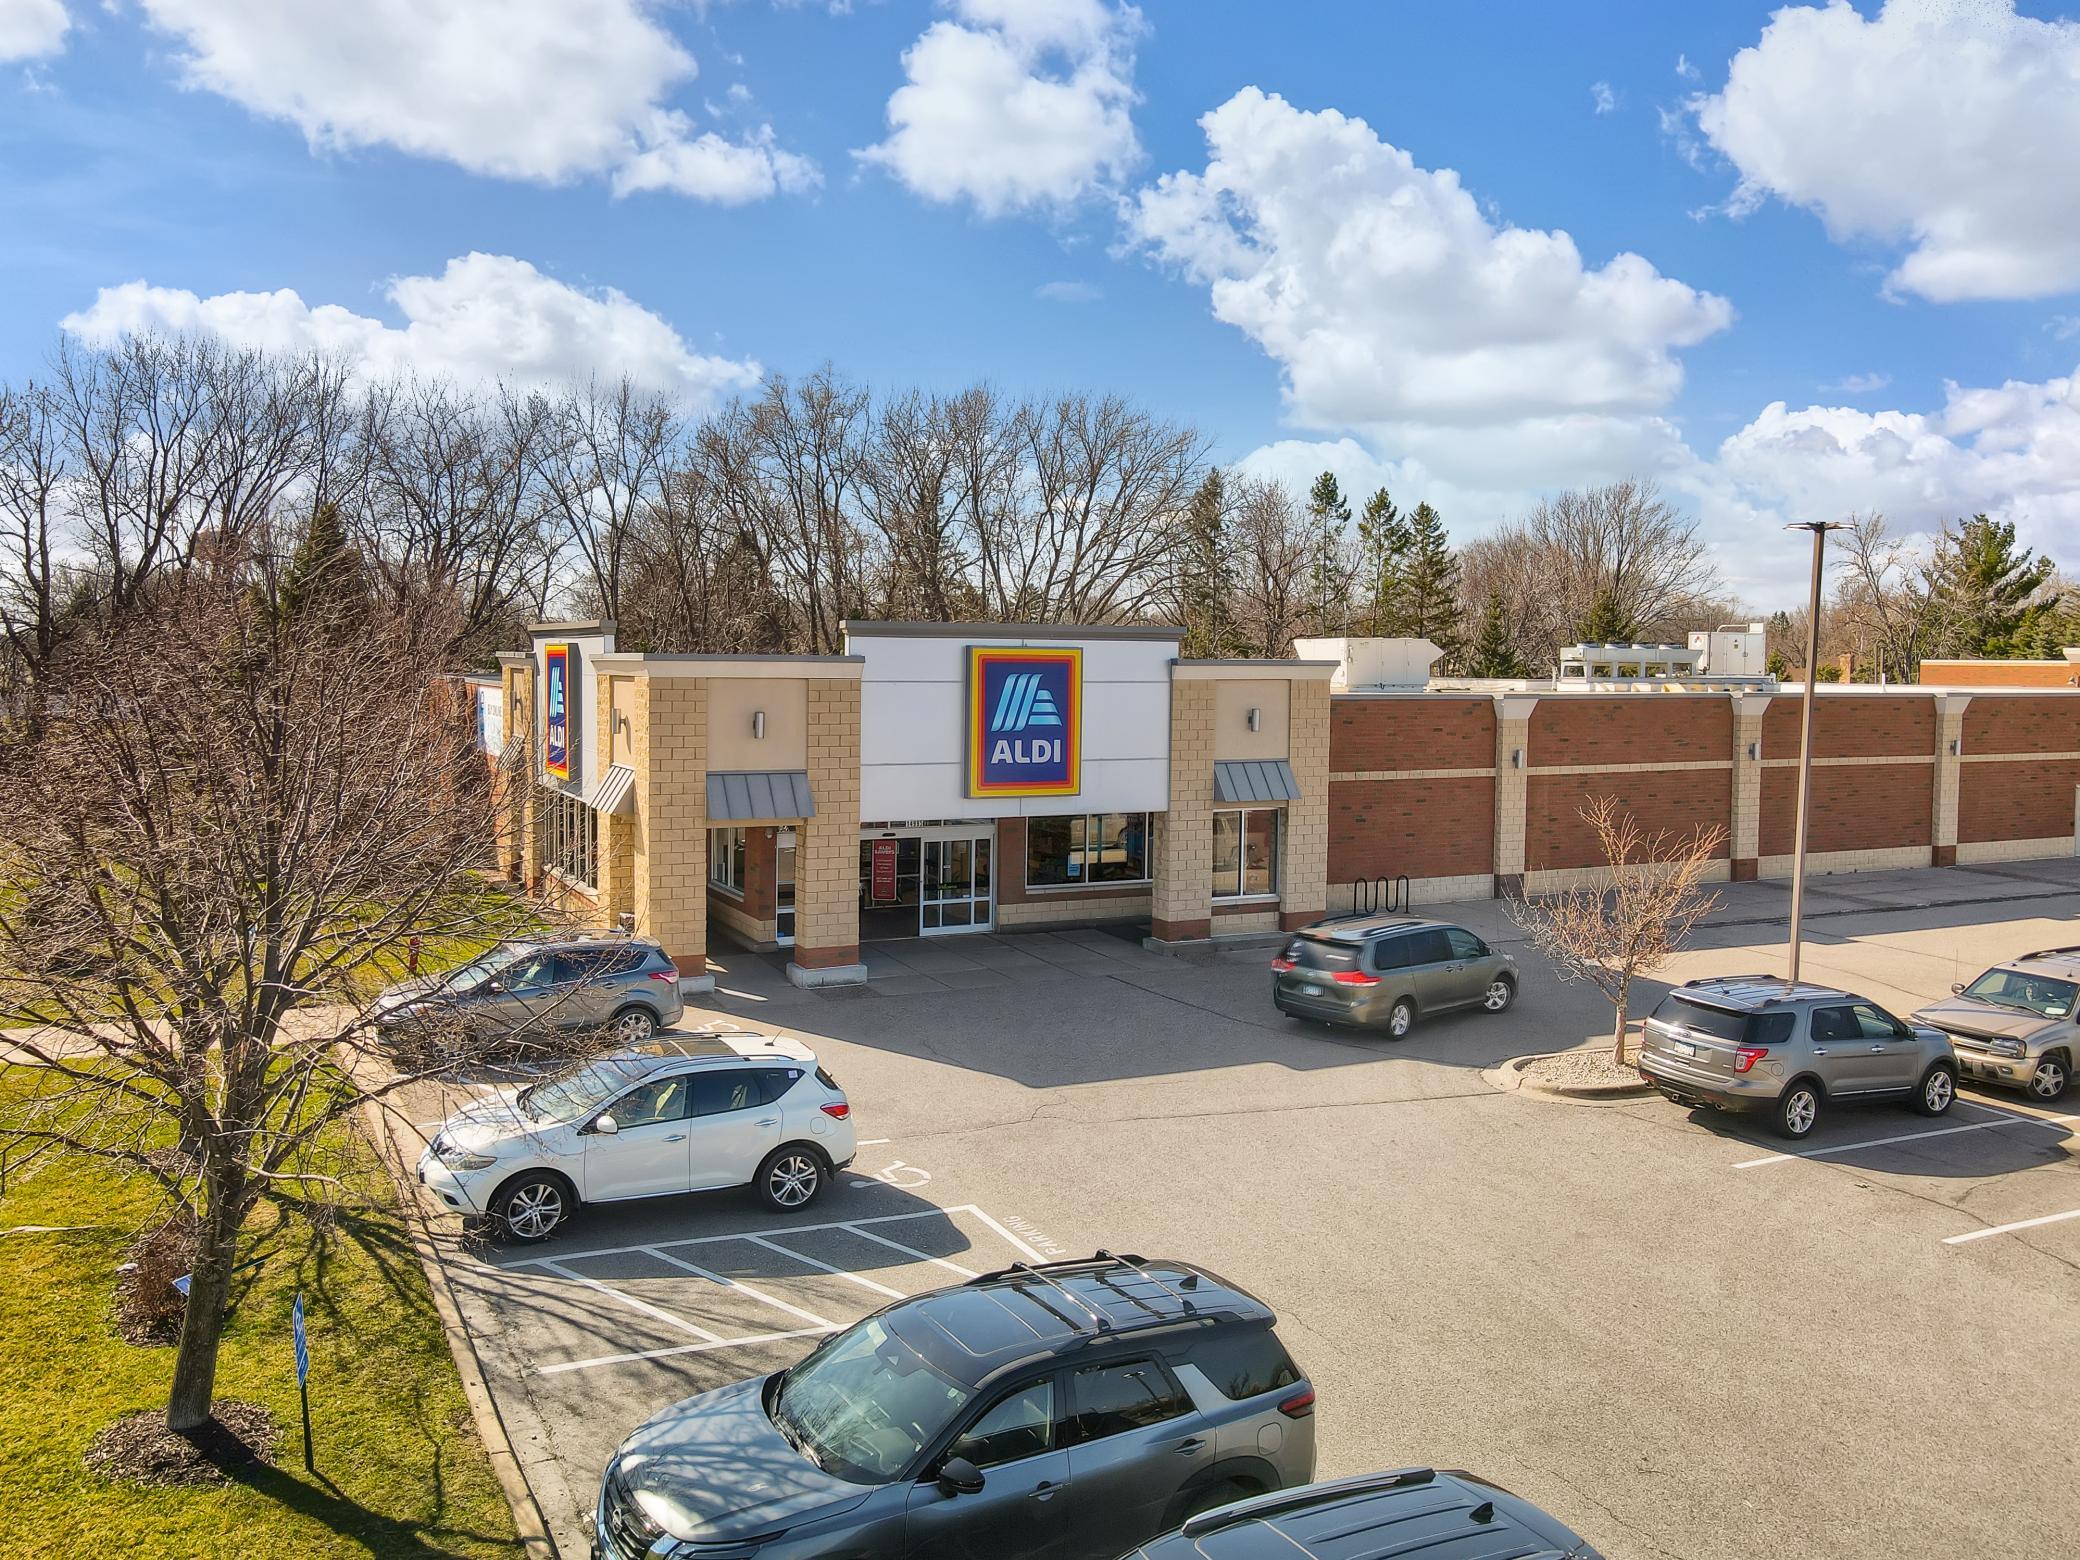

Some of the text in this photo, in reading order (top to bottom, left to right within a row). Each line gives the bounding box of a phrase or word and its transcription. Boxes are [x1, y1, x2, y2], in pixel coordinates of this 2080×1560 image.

[550, 724, 565, 748] ALDI
[990, 739, 1061, 764] ALDI
[1002, 1215, 1066, 1255] PARKING
